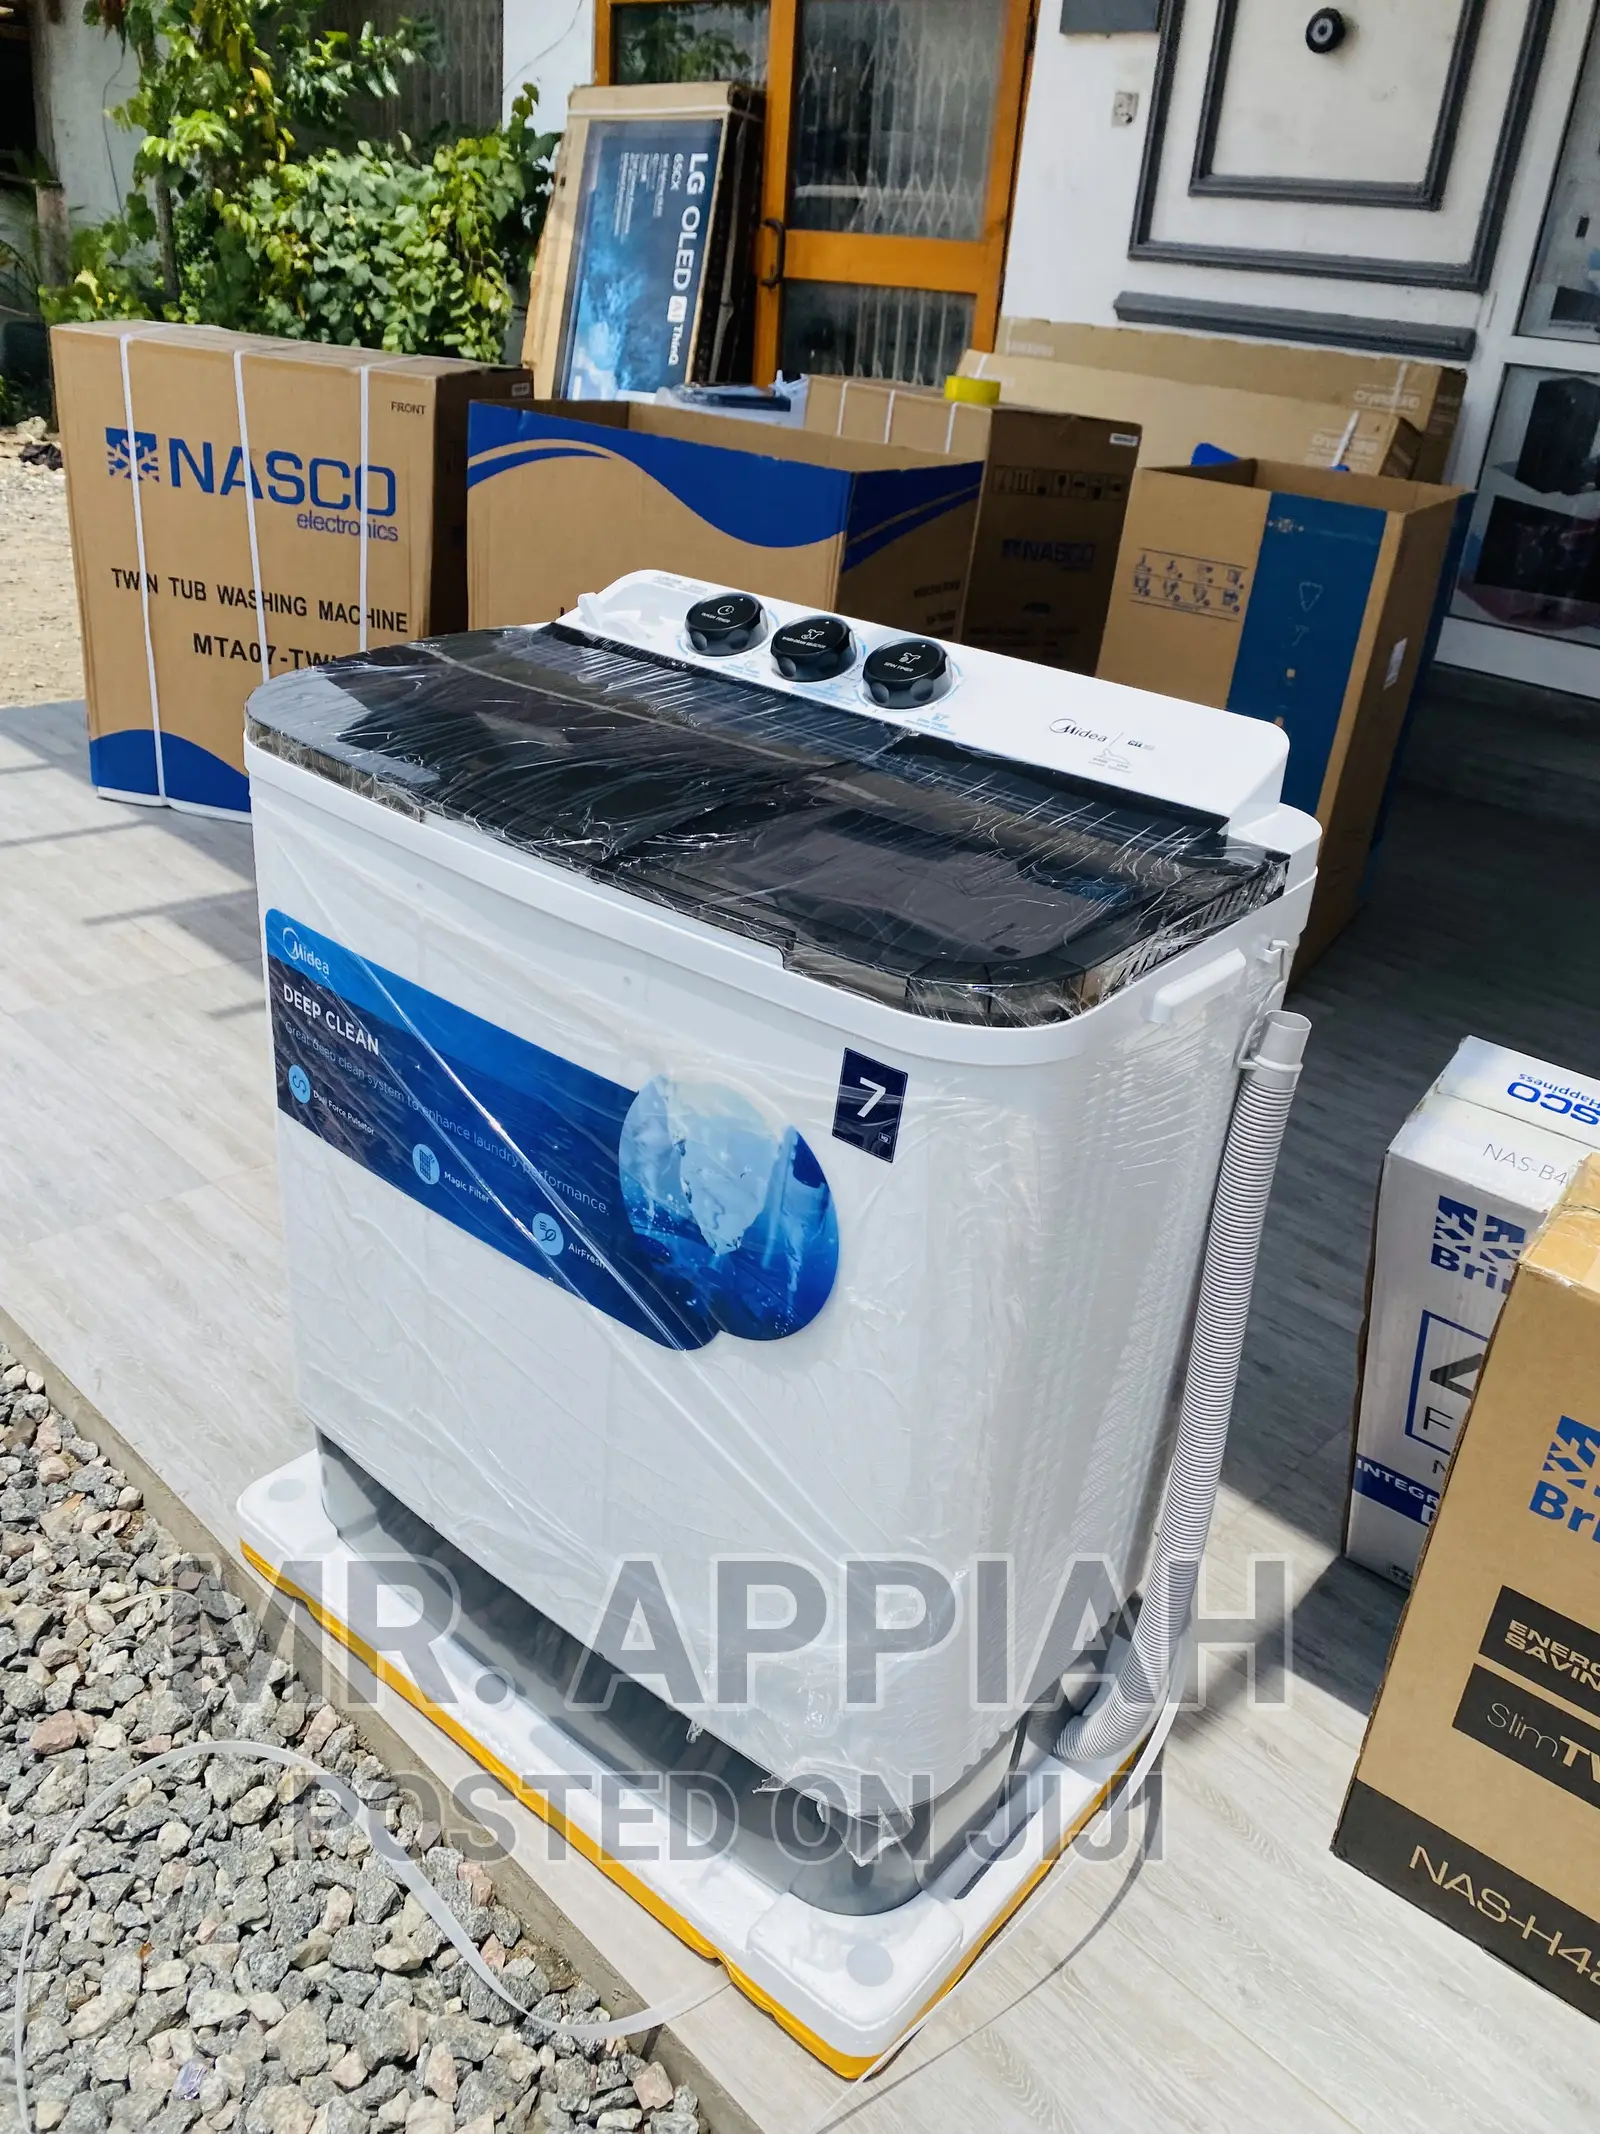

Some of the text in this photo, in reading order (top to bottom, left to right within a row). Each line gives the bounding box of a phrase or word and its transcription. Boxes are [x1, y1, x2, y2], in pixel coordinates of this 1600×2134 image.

[686, 152, 709, 195] LG
[673, 205, 701, 292] OLED
[390, 400, 427, 415] FRONT
[168, 437, 397, 517] NASCO
[110, 567, 409, 633] TWN TUB WASHING MACHINE
[1049, 718, 1109, 743] Midea
[283, 927, 330, 976] Midea
[283, 983, 379, 1056] DEEP CLEAN
[285, 1021, 311, 1046] Great
[312, 1038, 336, 1062] deep
[338, 1056, 365, 1080] clean
[367, 1073, 405, 1102] system
[407, 1094, 420, 1111] to
[473, 1131, 521, 1168] laundry
[312, 1090, 375, 1136] Dual Force Pulsator
[857, 1076, 887, 1118] 7
[443, 1171, 491, 1203] Magic Filter
